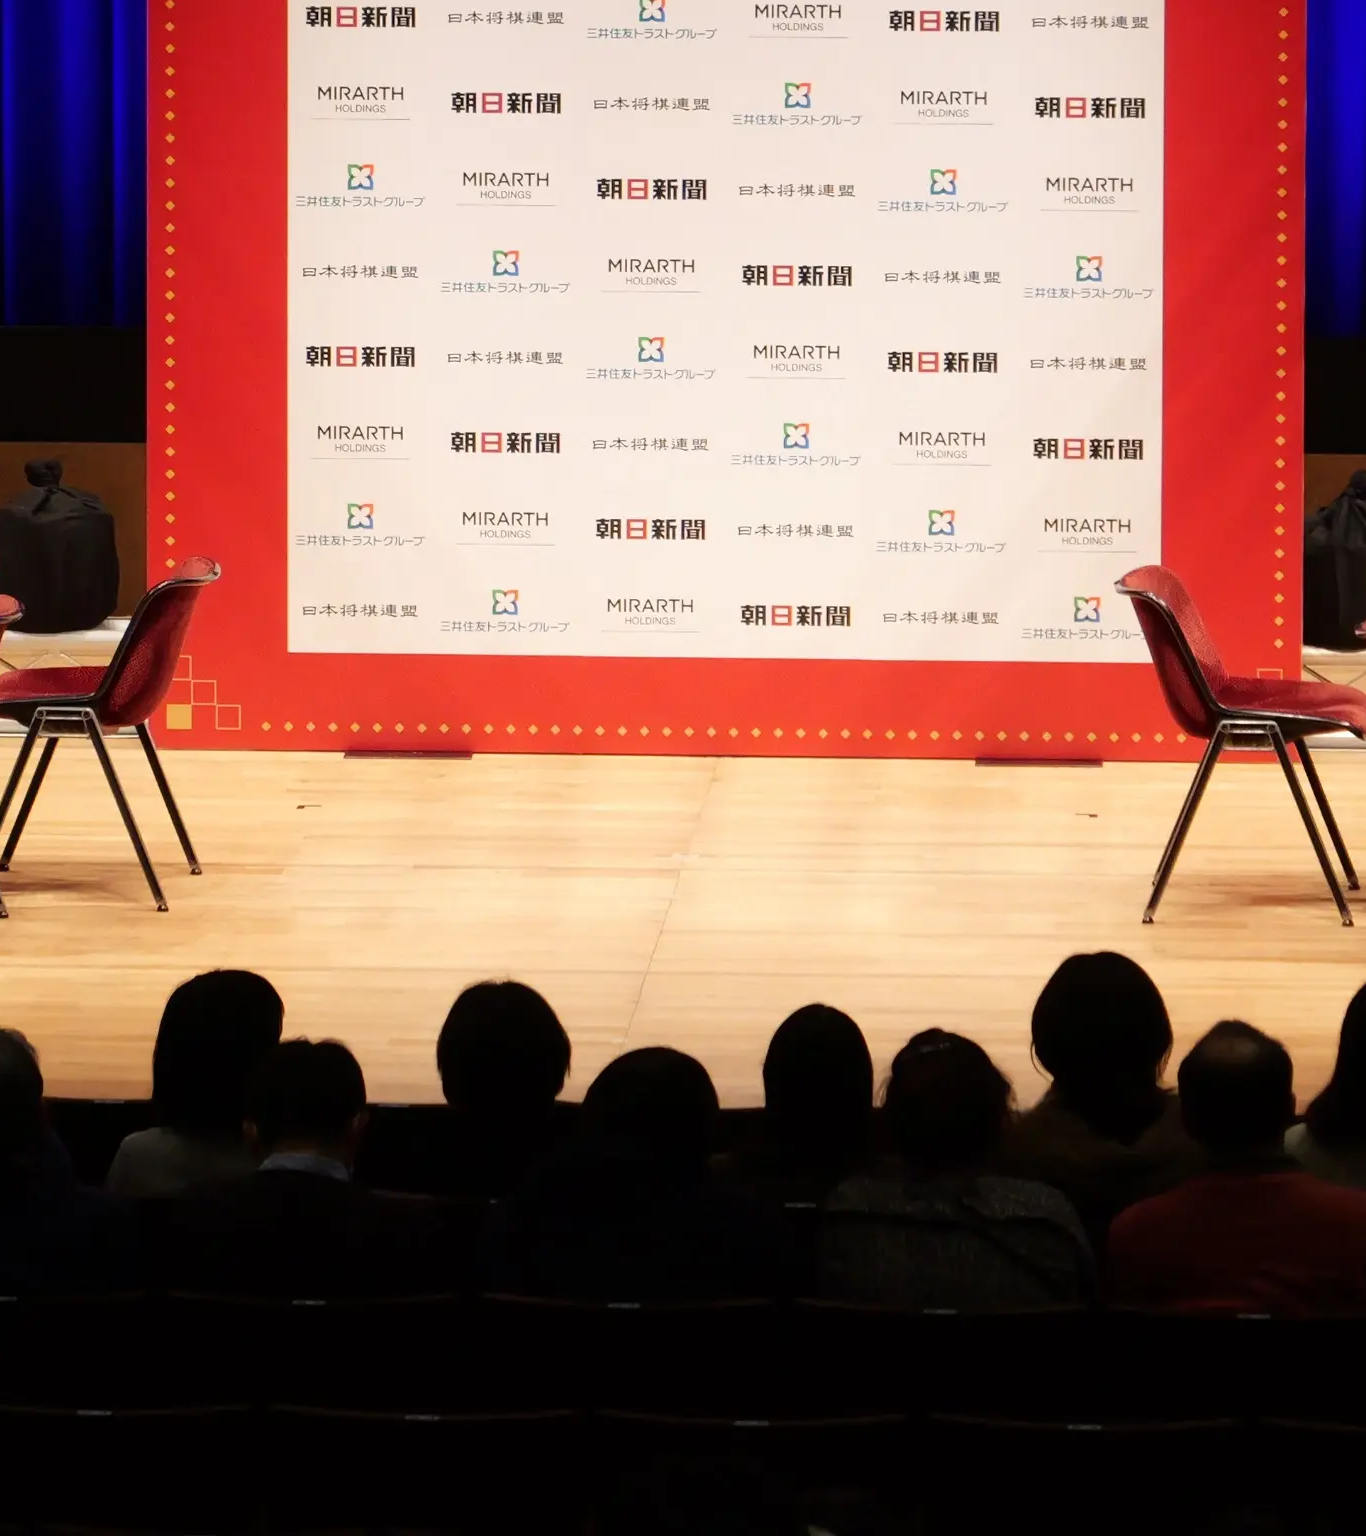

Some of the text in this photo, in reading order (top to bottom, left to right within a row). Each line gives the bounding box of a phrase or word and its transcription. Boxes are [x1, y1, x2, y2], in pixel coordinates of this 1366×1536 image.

[306, 6, 415, 27] 朝日新聞
[448, 11, 564, 24] 日本将棋連盟
[755, 4, 841, 18] MIRARTH
[773, 22, 823, 31] HOLDINGS
[889, 10, 999, 32] 朝日新聞
[1032, 16, 1149, 29] 日本将棋連盟
[587, 28, 717, 39] 三井住友トラストグループ
[318, 86, 403, 100] MIRARTH
[901, 91, 987, 105] MIRARTH
[335, 104, 386, 113] HOLDINGS
[452, 92, 561, 114] 朝日新聞
[594, 97, 710, 111] 日本将棋連盟
[1035, 97, 1145, 118] 朝日新聞
[733, 114, 861, 125] 三井住友トラストグループ
[918, 109, 969, 117] HOLDINGS
[463, 172, 548, 186] MIRARTH
[1047, 178, 1133, 192] MIRARTH
[481, 191, 531, 199] HOLDINGS
[597, 179, 706, 200] 朝日新聞
[739, 184, 855, 197] 日本将棋連盟
[296, 196, 424, 207] 三井住友トラストグループ
[878, 201, 1008, 212] 三井住友トラストグループ
[1064, 196, 1115, 204] HOLDINGS
[303, 265, 418, 278] 日本将棋連盟
[609, 259, 694, 273] MIRARTH
[626, 277, 676, 285] HOLDINGS
[742, 265, 852, 286] 朝日新聞
[885, 270, 1001, 284] 日本将棋連盟
[441, 282, 570, 293] 三井住友トラストグループ
[1025, 288, 1154, 299] 三井住友トラストグループ
[306, 346, 415, 367] 朝日新聞
[448, 351, 563, 364] 日本将棋連盟
[754, 345, 839, 359] MIRARTH
[771, 364, 822, 372] HOLDINGS
[888, 352, 997, 373] 朝日新聞
[1031, 357, 1147, 370] 日本将棋連盟
[586, 368, 716, 379] 三井住友トラストグループ
[318, 426, 403, 440] MIRARTH
[899, 432, 985, 446] MIRARTH
[335, 444, 385, 452] HOLDINGS
[451, 432, 560, 453] 朝日新聞
[593, 437, 708, 451] 日本将棋連盟
[1033, 438, 1143, 460] 朝日新聞
[732, 455, 861, 466] 三井住友トラストグループ
[917, 450, 967, 459] HOLDINGS
[463, 512, 548, 526] MIRARTH
[596, 519, 705, 540] 朝日新聞
[738, 524, 853, 537] 日本将棋連盟
[1045, 519, 1130, 533] MIRARTH
[295, 535, 425, 546] 三井住友トラストグループ
[480, 530, 530, 538] HOLDINGS
[1062, 536, 1113, 545] HOLDINGS
[876, 541, 1006, 553] 三井住友トラストグループ
[303, 604, 417, 617] 日本将棋連盟
[608, 599, 693, 612] MIRARTH
[625, 617, 675, 625] HOLDINGS
[741, 605, 850, 626] 朝日新聞
[883, 611, 999, 624] 日本将棋連盟
[441, 621, 569, 632] 三井住友トラストグループ
[1022, 628, 1144, 640] 三井住友トラストグルー
